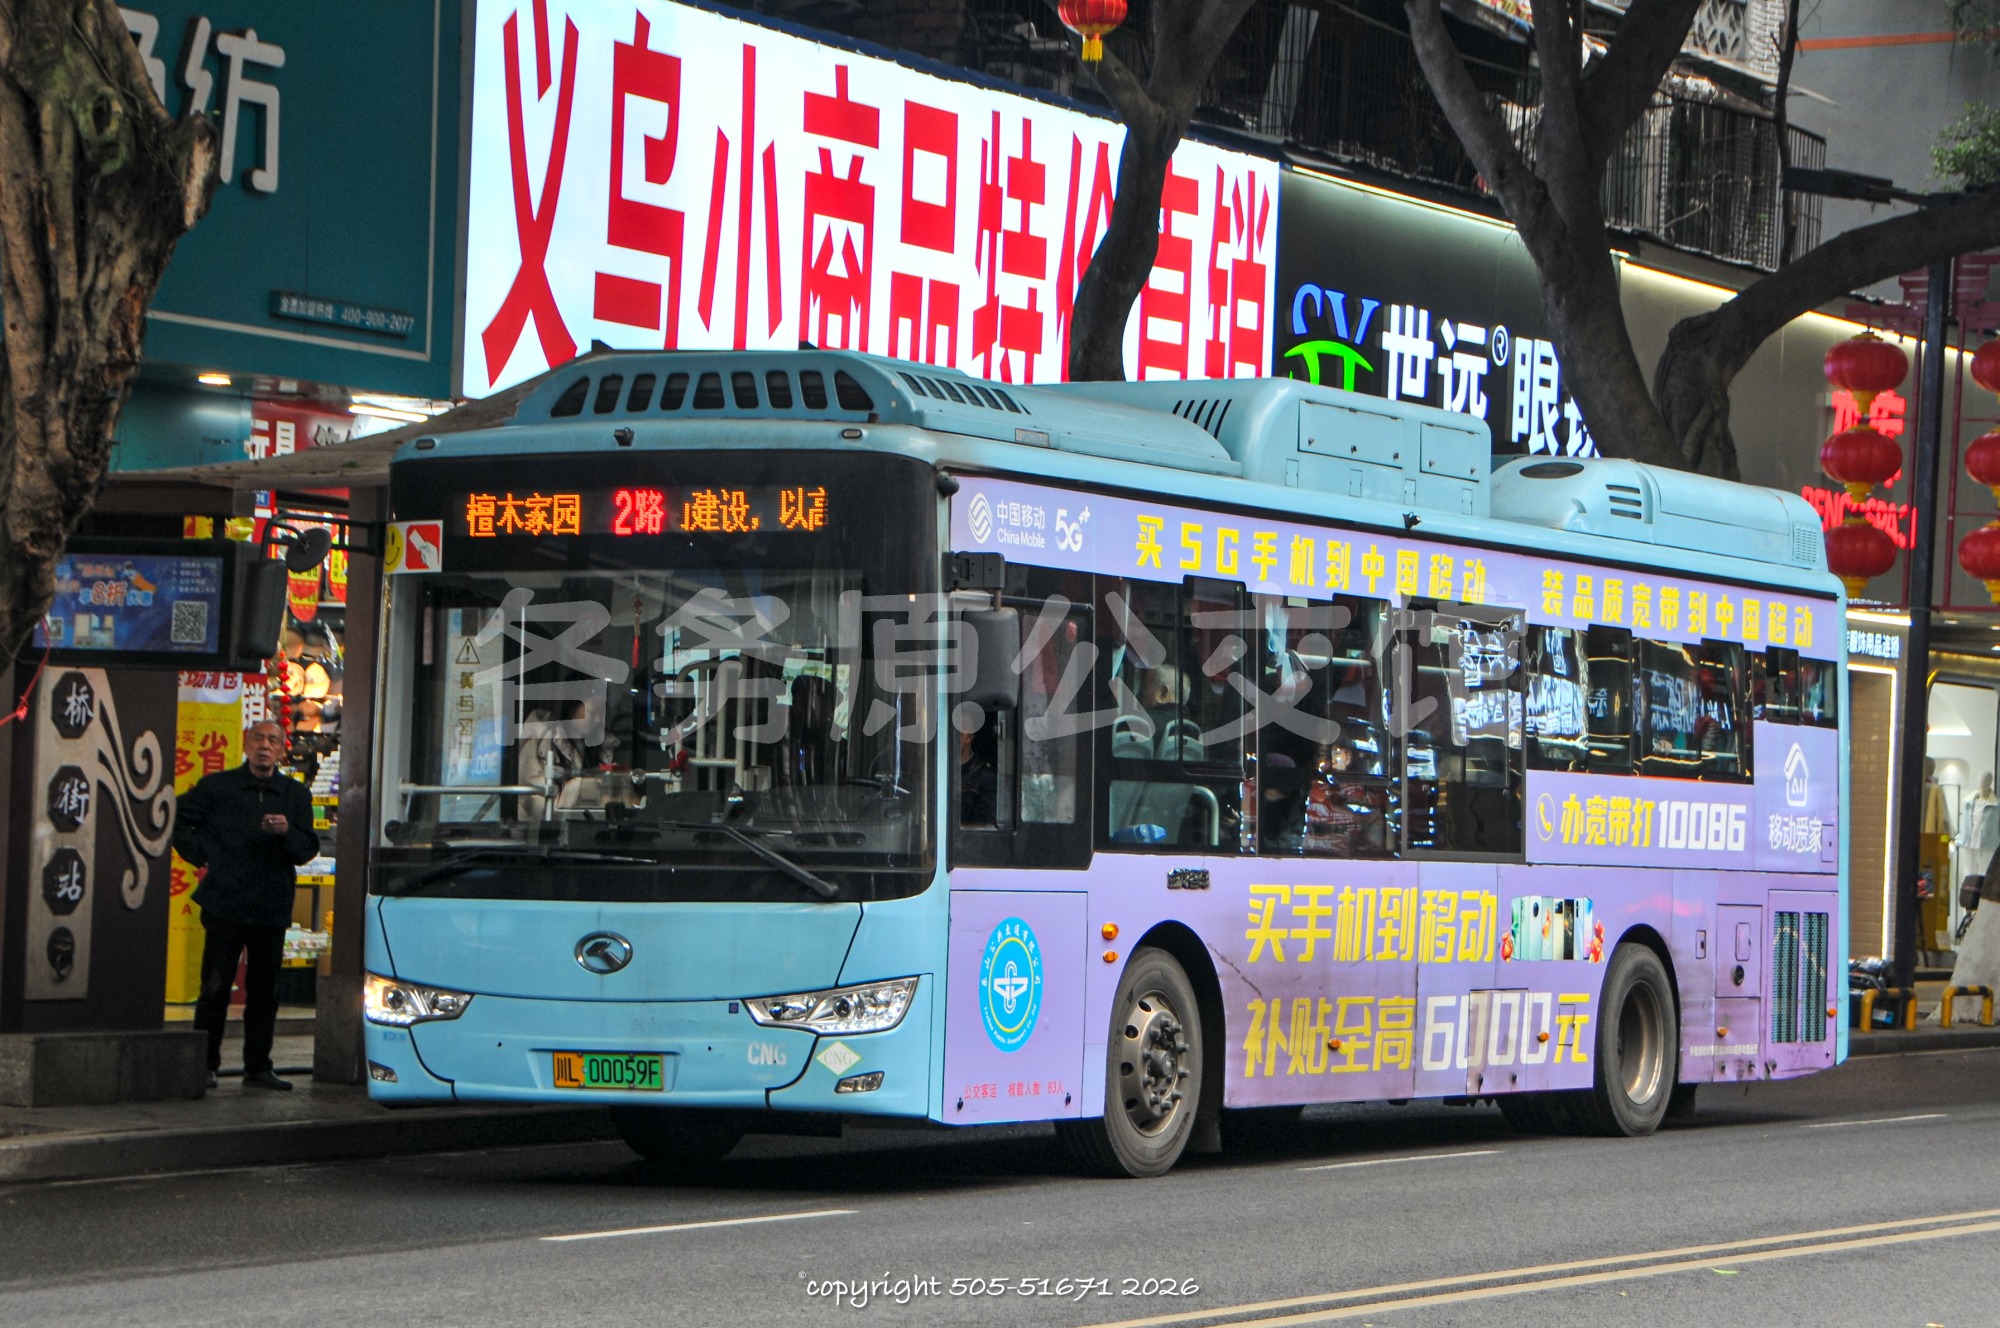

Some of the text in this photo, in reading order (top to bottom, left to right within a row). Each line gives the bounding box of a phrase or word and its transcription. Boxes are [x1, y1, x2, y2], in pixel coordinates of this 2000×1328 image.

[118, 8, 286, 193] 纺
[466, 493, 580, 537] 檀木家园
[614, 489, 666, 536] 2路
[997, 500, 1045, 530] 中国移动
[997, 527, 1046, 549] China Mobile
[1134, 514, 1813, 648] 买5G手机到中国移动 装品质宽带到中国移动
[1768, 813, 1823, 853] 移动爱家
[1245, 883, 1498, 964] 买手机到移动
[1243, 989, 1590, 1079] 补贴至高6000元
[556, 1056, 660, 1085] 川L 00059F
[747, 1042, 787, 1065] CNG
[823, 1050, 852, 1065] CNG
[964, 1083, 997, 1099] 公交客运
[1047, 1080, 1064, 1094] 83人
